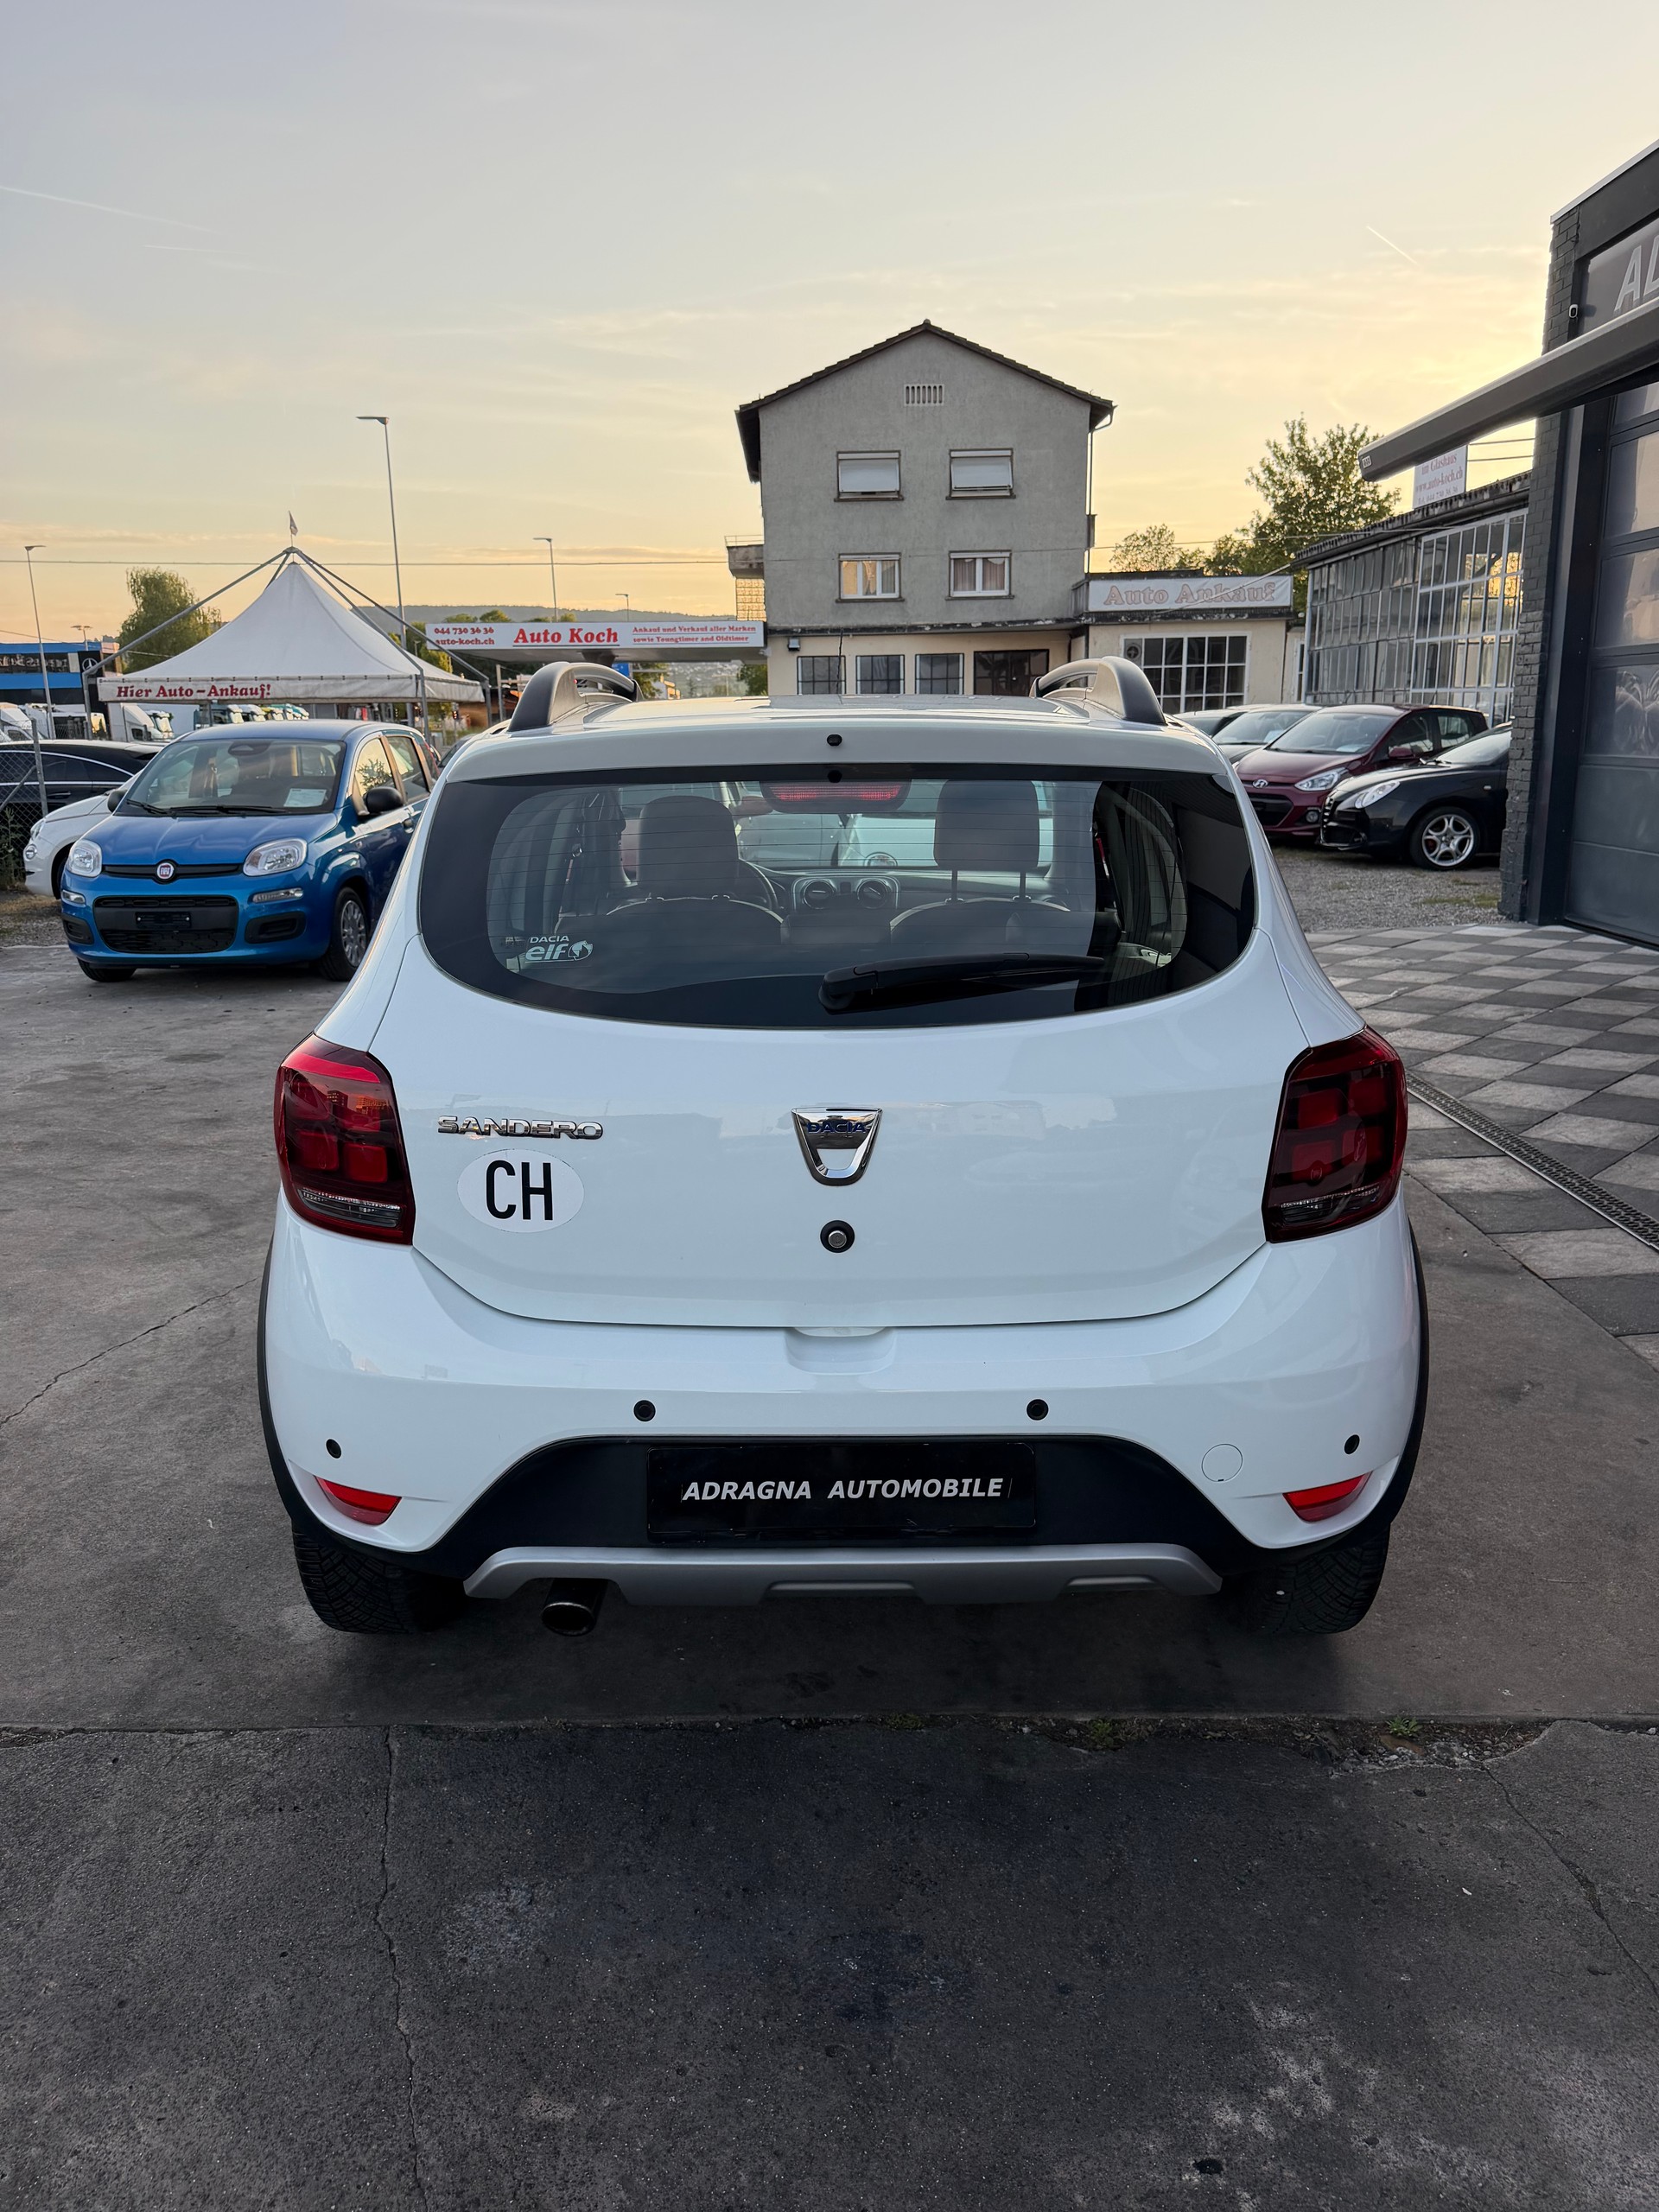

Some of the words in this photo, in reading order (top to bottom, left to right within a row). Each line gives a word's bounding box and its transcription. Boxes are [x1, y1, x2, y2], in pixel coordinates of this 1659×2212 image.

[1103, 584, 1169, 605] Auto
[1175, 582, 1276, 604] Ankauf
[470, 626, 481, 635] 36
[514, 628, 562, 644] Auto
[569, 627, 619, 644] Koch
[117, 685, 153, 698] Hier
[530, 935, 569, 944] DACIA
[525, 943, 569, 961] elf
[437, 1116, 604, 1140] SANDERO
[807, 1122, 867, 1134] DACIA
[486, 1160, 553, 1221] CH
[682, 1480, 812, 1501] ADRAGNA
[827, 1478, 1004, 1499] AUTOMOBILE
